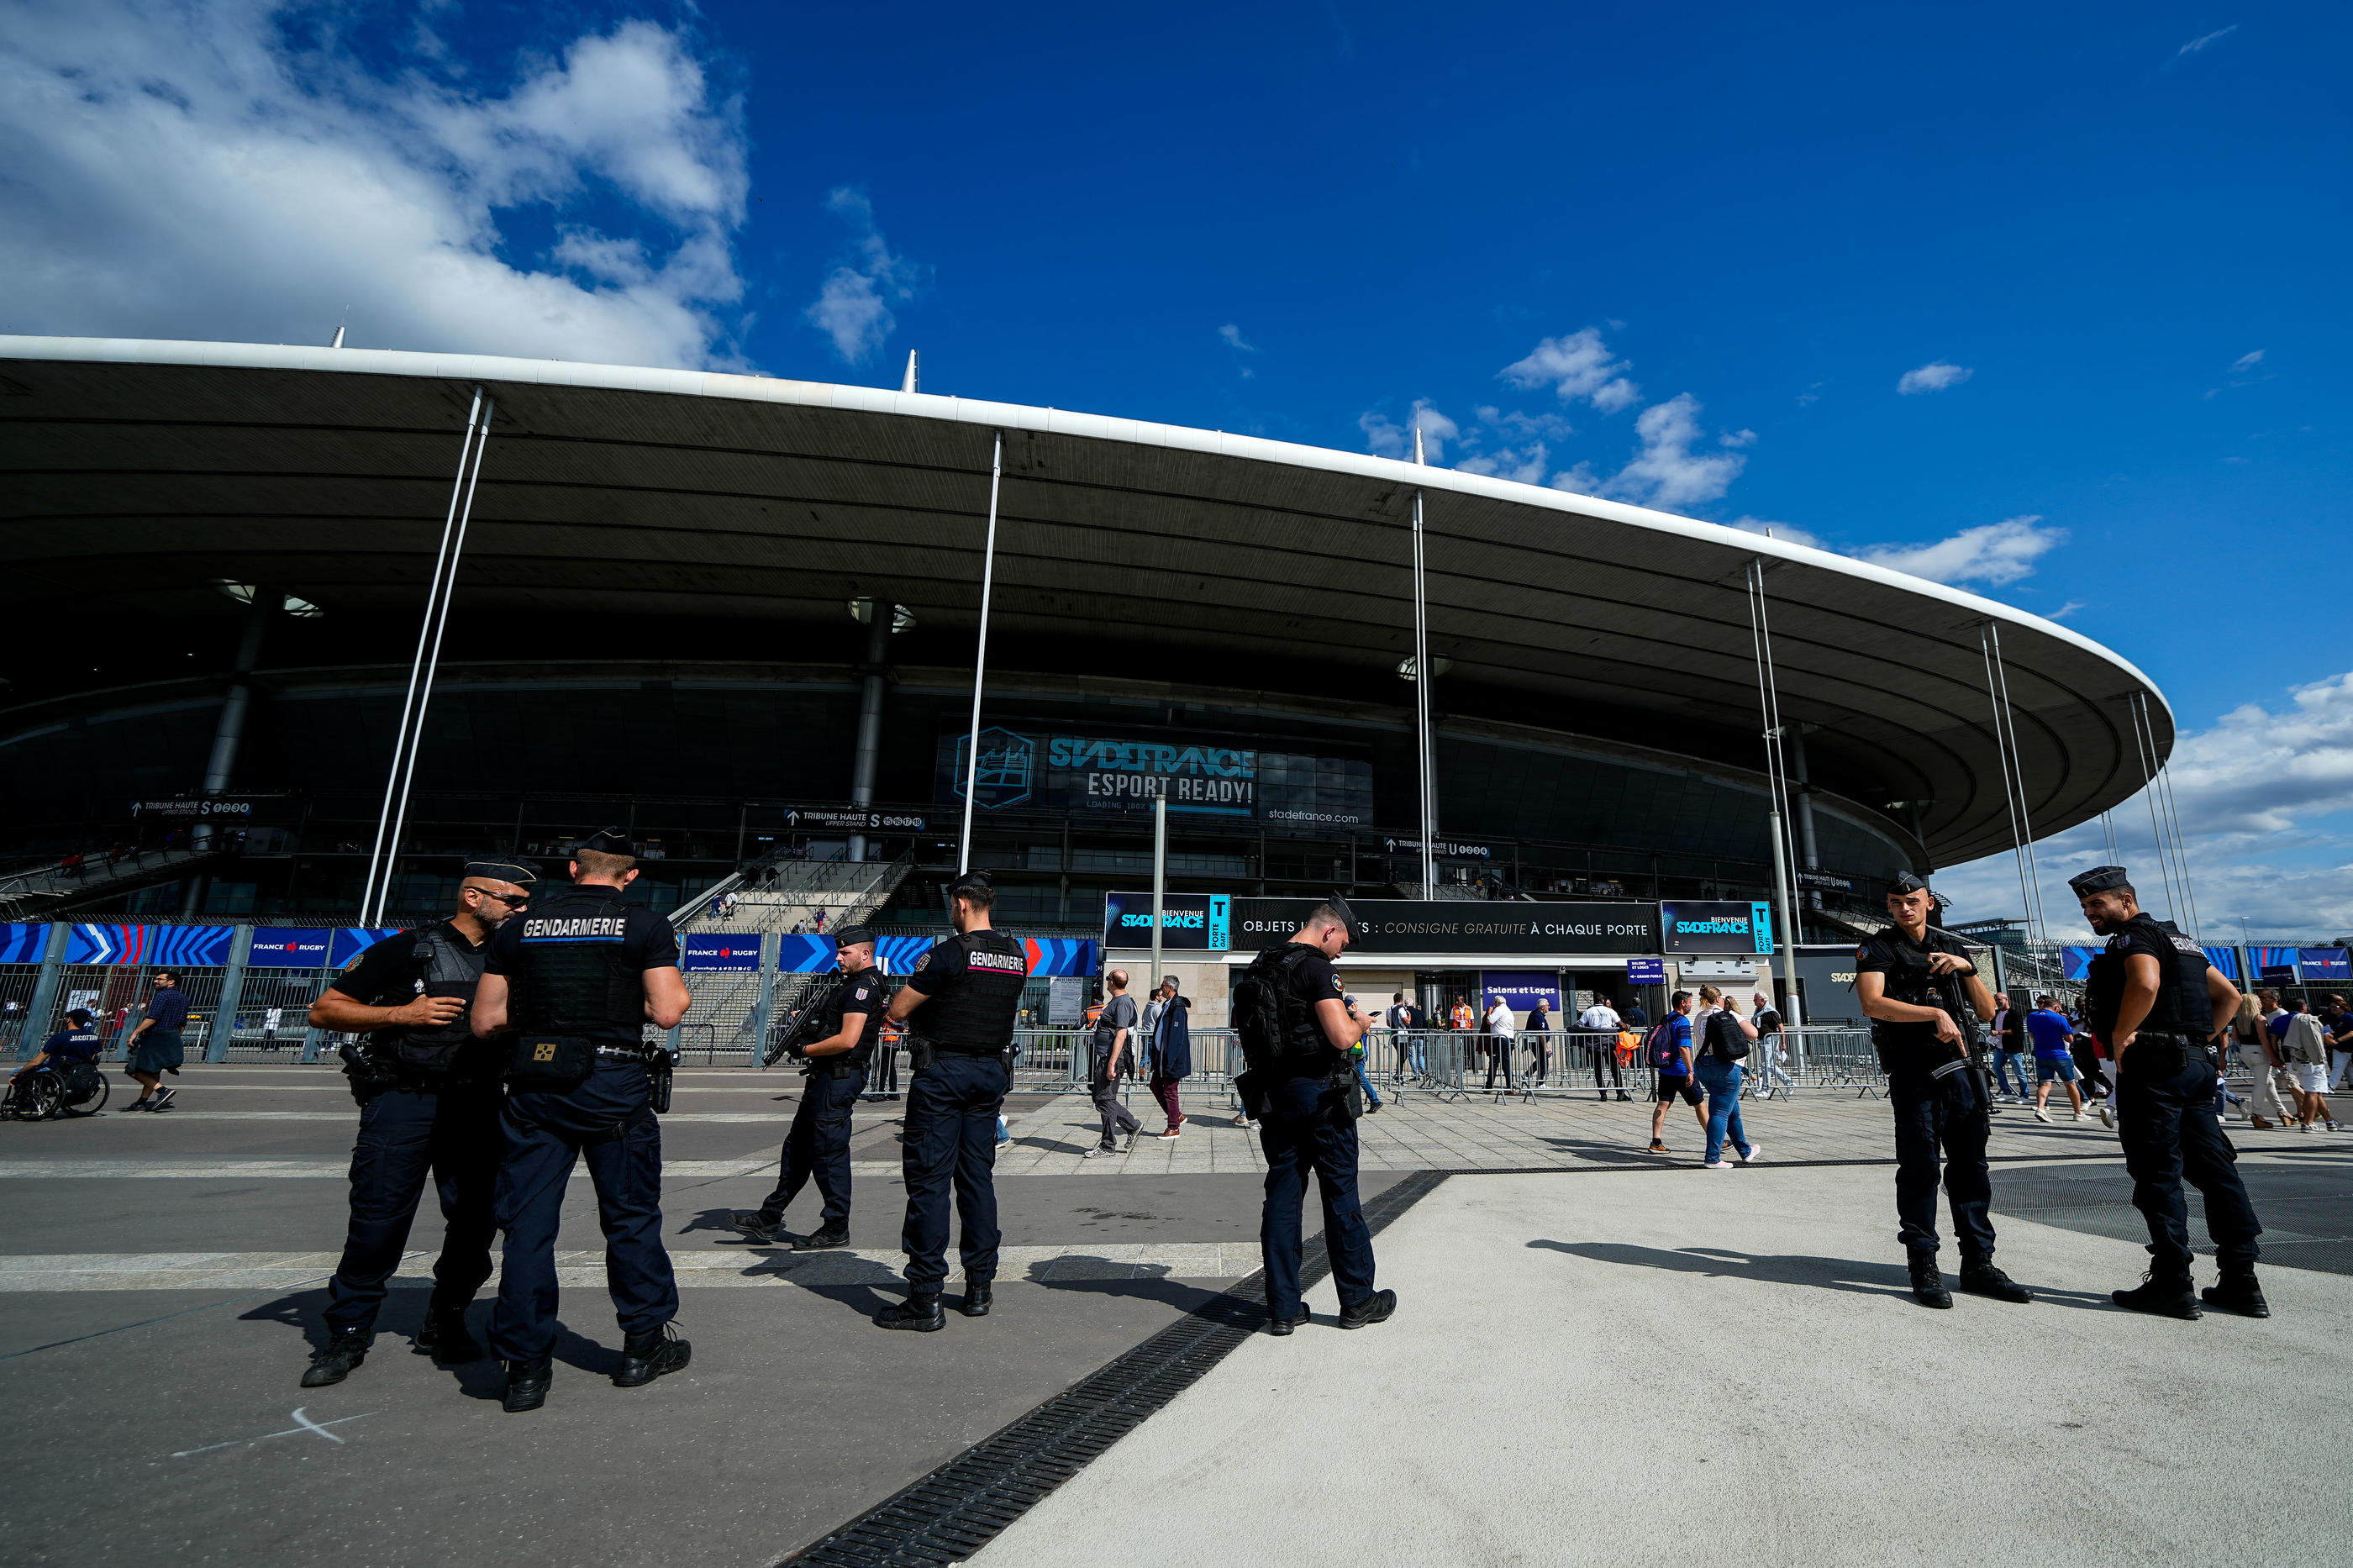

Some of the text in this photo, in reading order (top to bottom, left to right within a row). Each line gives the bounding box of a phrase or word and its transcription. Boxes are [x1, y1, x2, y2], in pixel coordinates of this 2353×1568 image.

[1050, 738, 1254, 778] STADEFRANCE
[1088, 773, 1253, 803] ESPORT READY!
[200, 801, 211, 815] S
[1087, 801, 1121, 809] LOADING
[870, 814, 880, 827] S
[1269, 809, 1358, 823] stadefrance.com
[1449, 844, 1457, 855] U
[1214, 901, 1226, 916] T
[1756, 908, 1766, 923] T
[524, 918, 625, 937] GENDARMERIE
[1121, 914, 1203, 928] STADRANCE
[1243, 921, 1295, 932] OBJETS
[1677, 921, 1749, 934] STADEFRANCE
[1384, 922, 1459, 934] CONSIGNE
[1464, 923, 1526, 935] GRATUITE
[1531, 921, 1540, 935] À
[1545, 924, 1602, 936] CHAQUE
[1607, 924, 1648, 936] PORTE
[970, 951, 1023, 971] GENDARMERIE
[1530, 987, 1555, 995] Loges
